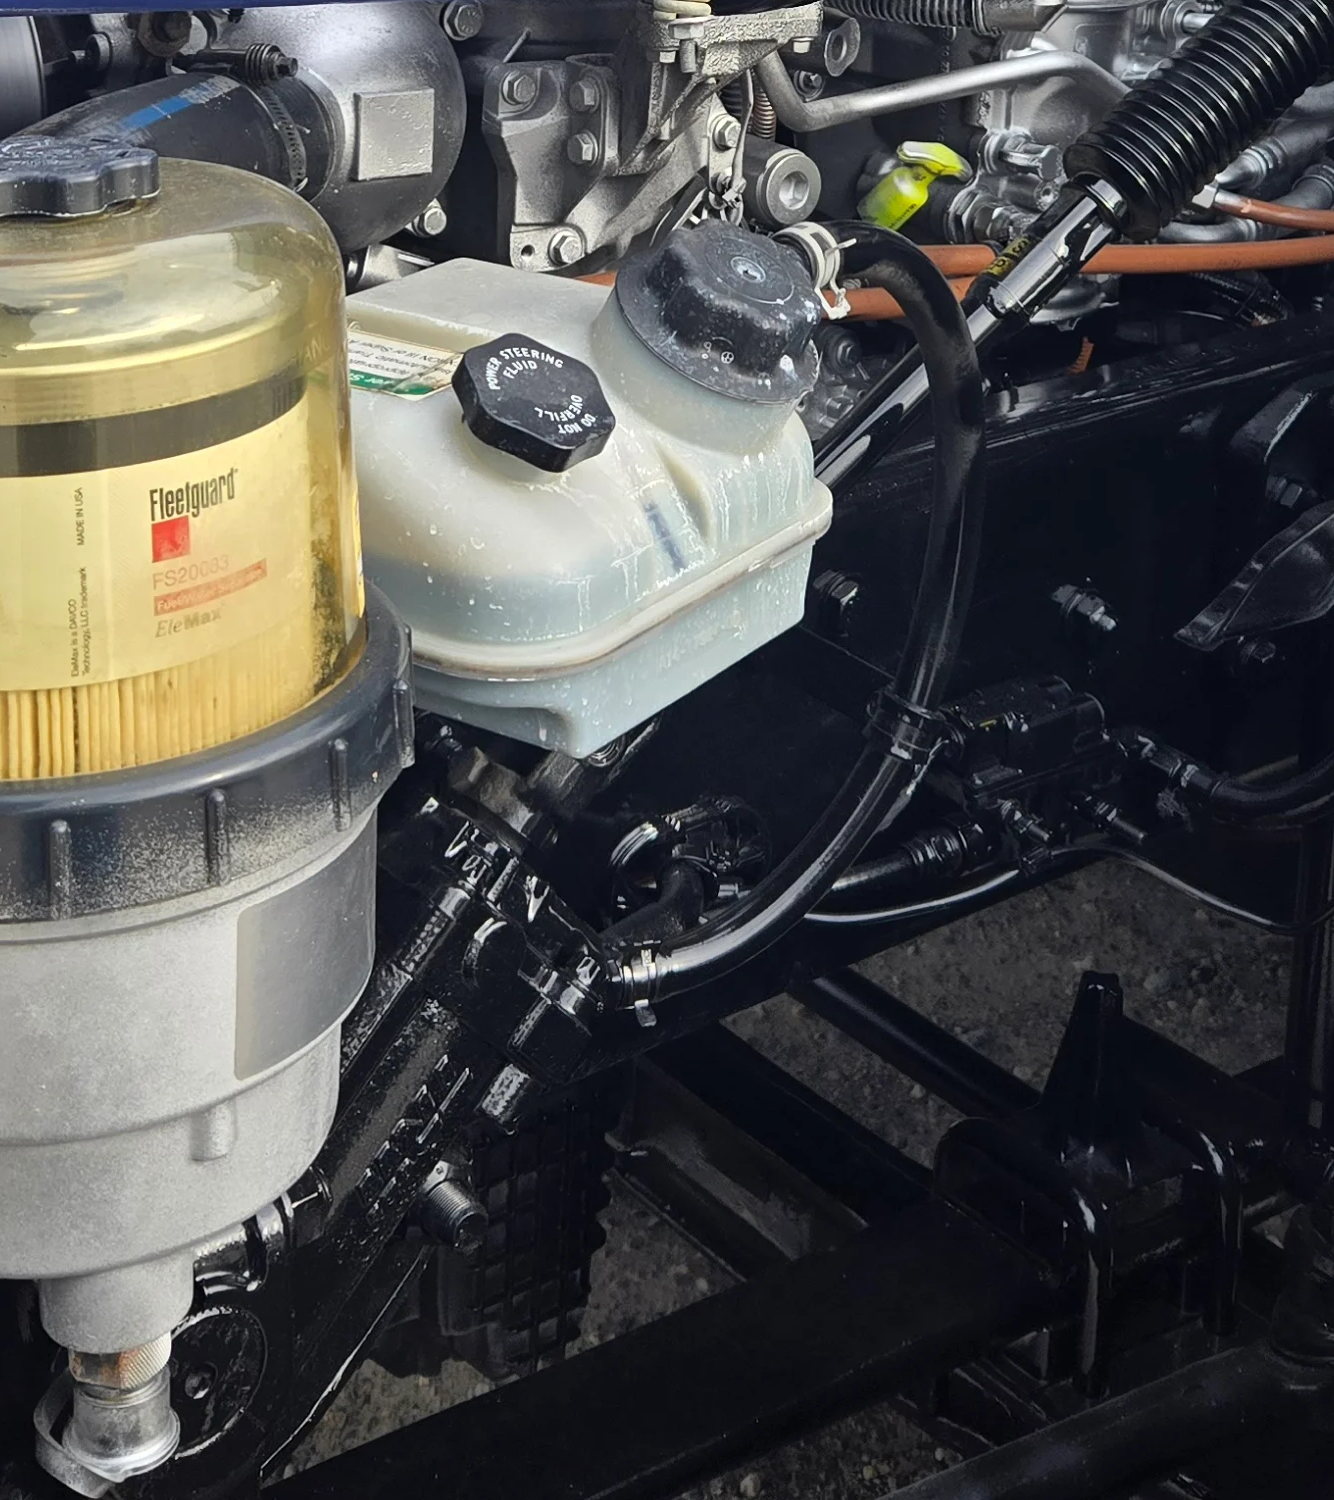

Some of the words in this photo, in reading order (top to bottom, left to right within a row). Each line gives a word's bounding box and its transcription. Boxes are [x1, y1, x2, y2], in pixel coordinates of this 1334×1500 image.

[486, 357, 503, 390] POWER
[499, 347, 564, 369] STEERING
[503, 360, 538, 379] FLUID
[534, 394, 584, 422] OVERFILL
[557, 422, 583, 435] NOT
[580, 413, 597, 427] DO
[74, 487, 83, 506] USA
[149, 466, 235, 522] Fleetguard
[75, 508, 84, 518] IN
[76, 520, 85, 545] MADE
[78, 567, 89, 609] trademark
[80, 610, 89, 628] LLC
[155, 608, 222, 638] EleMax
